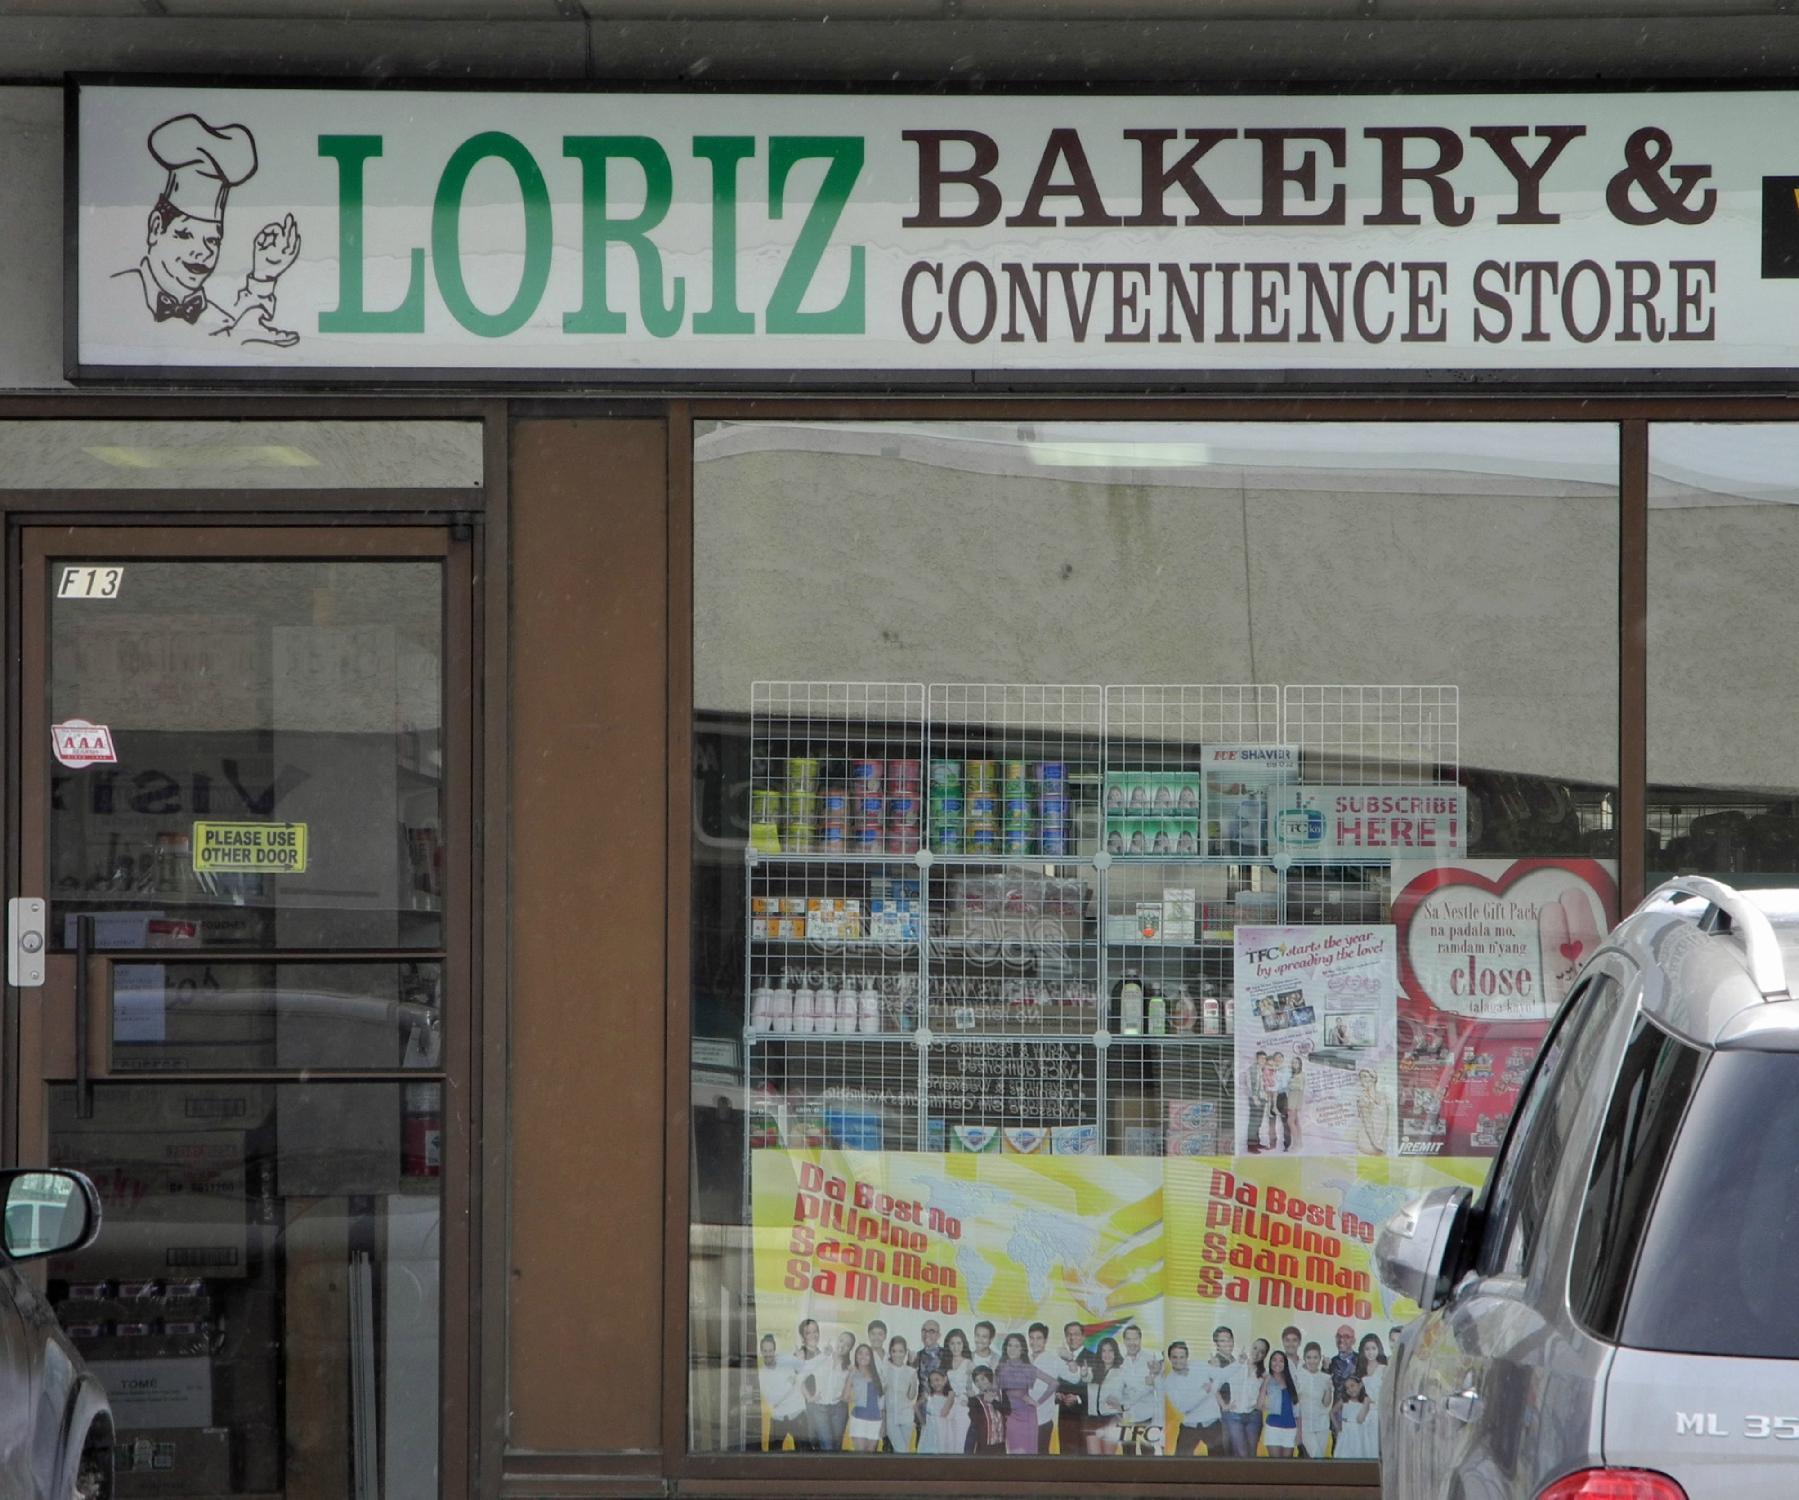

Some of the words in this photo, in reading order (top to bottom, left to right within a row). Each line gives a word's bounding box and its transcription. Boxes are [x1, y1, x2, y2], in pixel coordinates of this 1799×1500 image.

[901, 125, 1587, 228] BAKERY
[1605, 125, 1718, 226] &
[318, 130, 865, 338] LORIZ
[901, 261, 1448, 345] CONVENIENCE
[1473, 258, 1717, 343] STORE
[60, 568, 119, 597] F13
[62, 736, 105, 749] AAA
[1241, 748, 1292, 761] SHAVER
[1335, 795, 1458, 815] SUBSCRIBE
[204, 830, 262, 847] PLEASE
[266, 831, 297, 847] USE
[201, 847, 252, 864] OTHER
[256, 848, 299, 865] DOOR
[1483, 902, 1504, 920] Gift
[1510, 902, 1538, 921] Pack
[1430, 925, 1445, 937] na
[1449, 922, 1490, 941] padala
[1246, 946, 1280, 965] TFC
[1286, 941, 1321, 958] starts
[1324, 934, 1342, 949] the
[1256, 963, 1272, 980] by
[1274, 953, 1334, 976] spreading
[1336, 945, 1354, 961] the
[1357, 940, 1384, 957] love!
[1438, 940, 1485, 955] ramdam
[1450, 954, 1532, 997] close
[799, 1160, 846, 1202] Da
[853, 1181, 924, 1227] Best
[1209, 1167, 1259, 1208] Da
[1265, 1185, 1337, 1231] Best
[789, 1224, 887, 1273] Saan
[1201, 1231, 1300, 1279] Saan
[783, 1258, 837, 1297] Sa
[1197, 1265, 1250, 1303] Sa
[1115, 1423, 1164, 1442] TFC
[1675, 1411, 1730, 1437] ML
